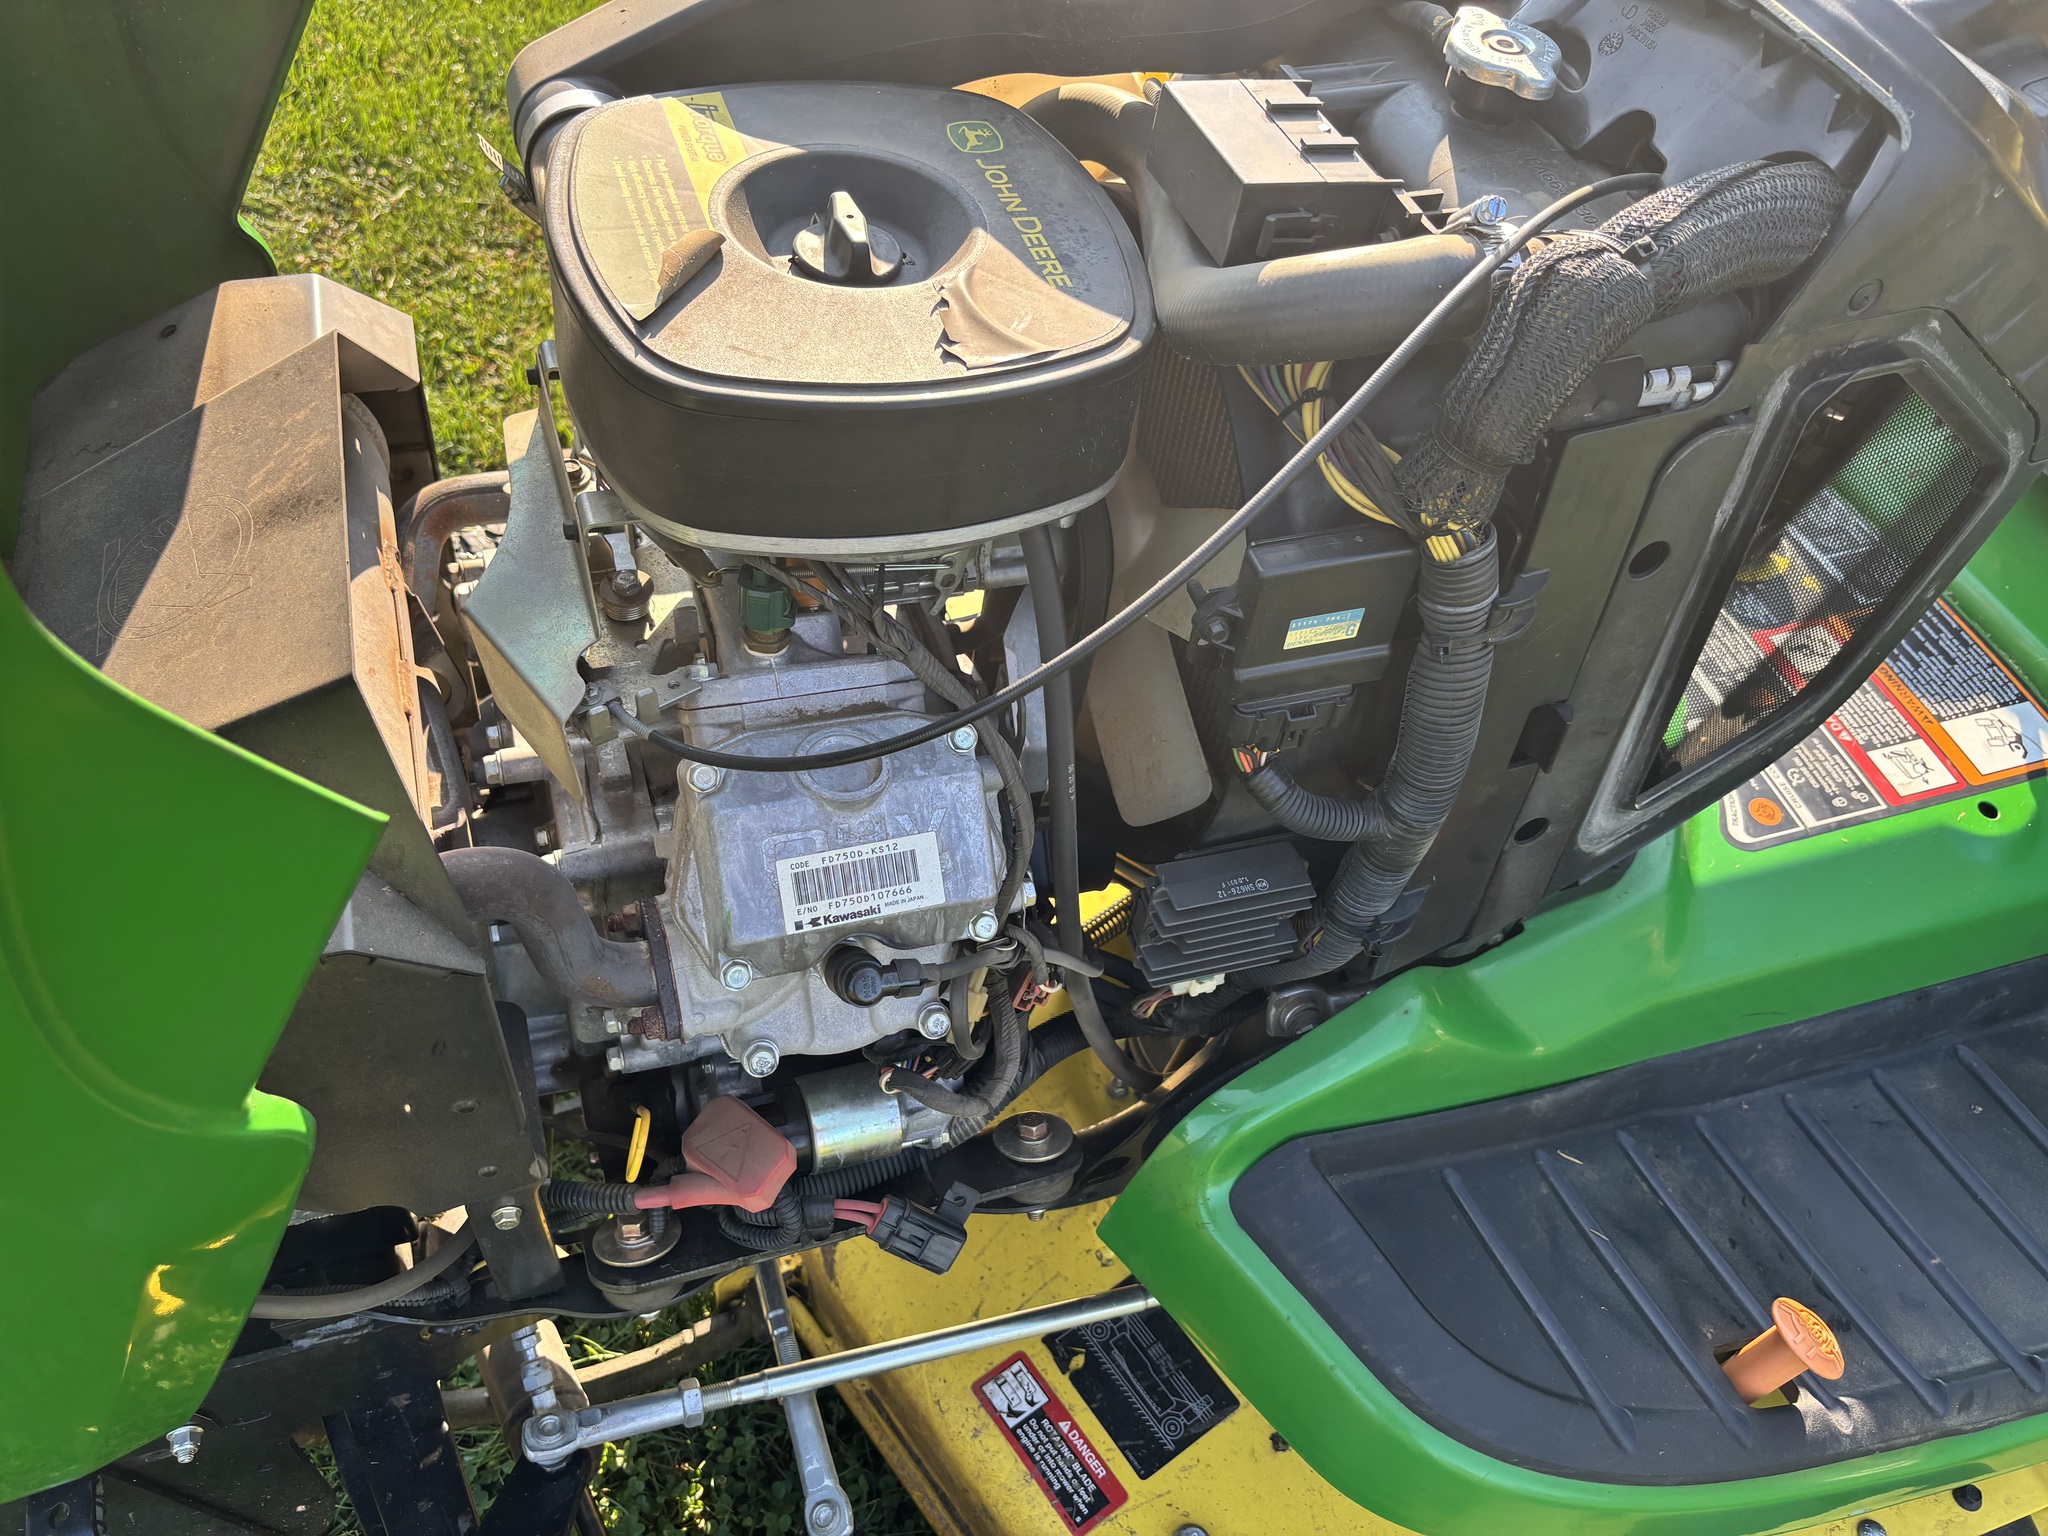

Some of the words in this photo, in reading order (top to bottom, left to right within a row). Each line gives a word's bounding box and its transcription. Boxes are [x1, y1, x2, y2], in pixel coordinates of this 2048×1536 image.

[977, 157, 1027, 220] JOHN
[1012, 216, 1074, 289] DEERE
[1345, 623, 1357, 636] G
[1876, 666, 1925, 715] WARNING
[790, 860, 810, 871] CODE
[821, 842, 899, 865] FD750D-KS12
[797, 905, 818, 916] E/NO
[828, 885, 912, 910] FD750D107666
[1216, 882, 1255, 898] SH626-12
[823, 904, 882, 925] Kawasaki
[1013, 1426, 1036, 1454] engine
[1032, 1451, 1042, 1461] is
[1037, 1459, 1062, 1490] running
[1021, 1422, 1040, 1445] under
[1036, 1443, 1046, 1454] or
[1043, 1452, 1057, 1469] into
[1053, 1467, 1075, 1495] mower
[1071, 1492, 1090, 1515] when
[1028, 1417, 1040, 1430] Do
[1036, 1428, 1049, 1443] not
[1043, 1441, 1058, 1457] put
[1054, 1454, 1074, 1479] hands
[1077, 1486, 1091, 1503] feet
[1067, 1428, 1107, 1479] DANGER
[1071, 1461, 1097, 1493] BLADE
